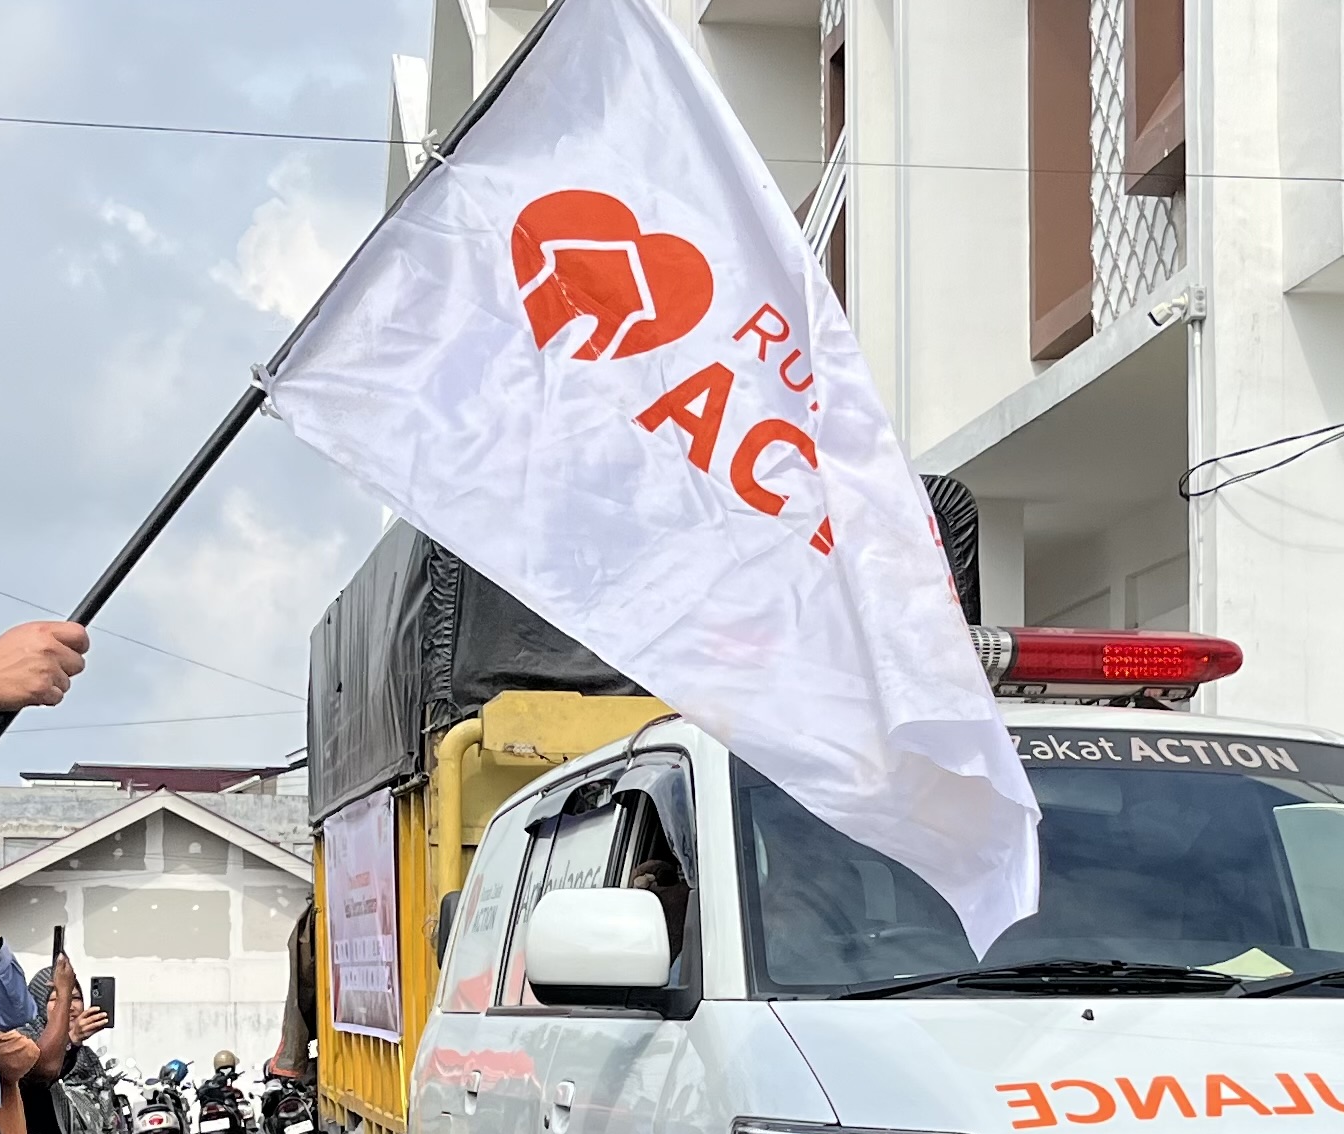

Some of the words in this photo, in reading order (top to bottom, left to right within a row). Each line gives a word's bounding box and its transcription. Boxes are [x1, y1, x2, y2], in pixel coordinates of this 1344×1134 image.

[732, 303, 820, 412] RU
[631, 361, 835, 556] AC
[1010, 734, 1122, 761] Zakat
[1130, 736, 1300, 773] ACTION
